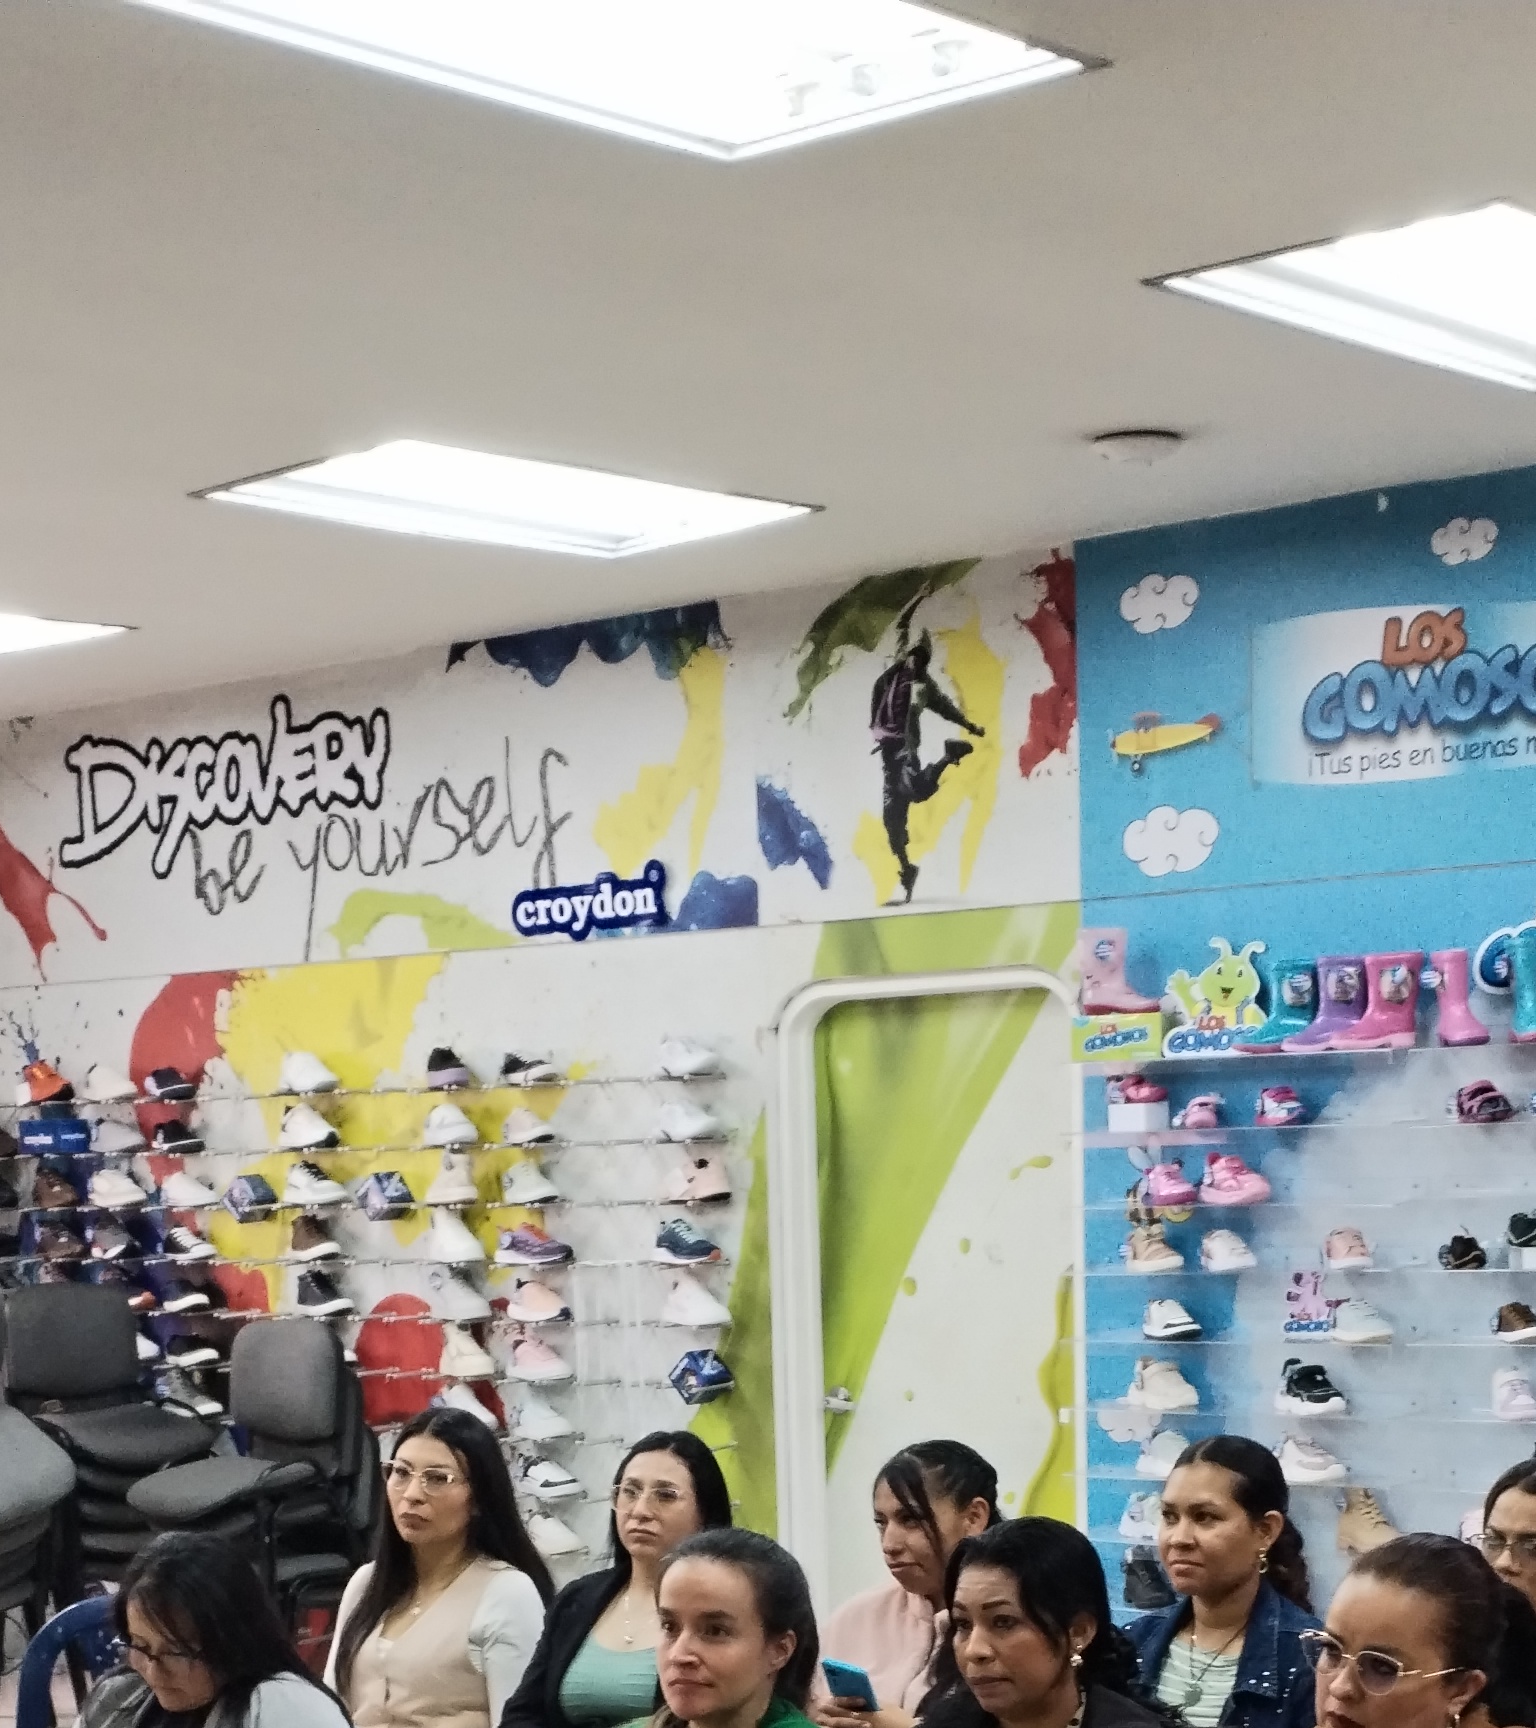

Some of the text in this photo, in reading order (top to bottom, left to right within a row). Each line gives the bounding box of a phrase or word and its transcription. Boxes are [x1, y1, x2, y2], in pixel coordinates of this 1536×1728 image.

[1381, 607, 1467, 666] LOS
[1359, 748, 1401, 780] pies
[1408, 748, 1434, 766] en
[1441, 736, 1518, 763] buenas
[189, 735, 572, 962] be yourself
[516, 883, 658, 931] croydon
